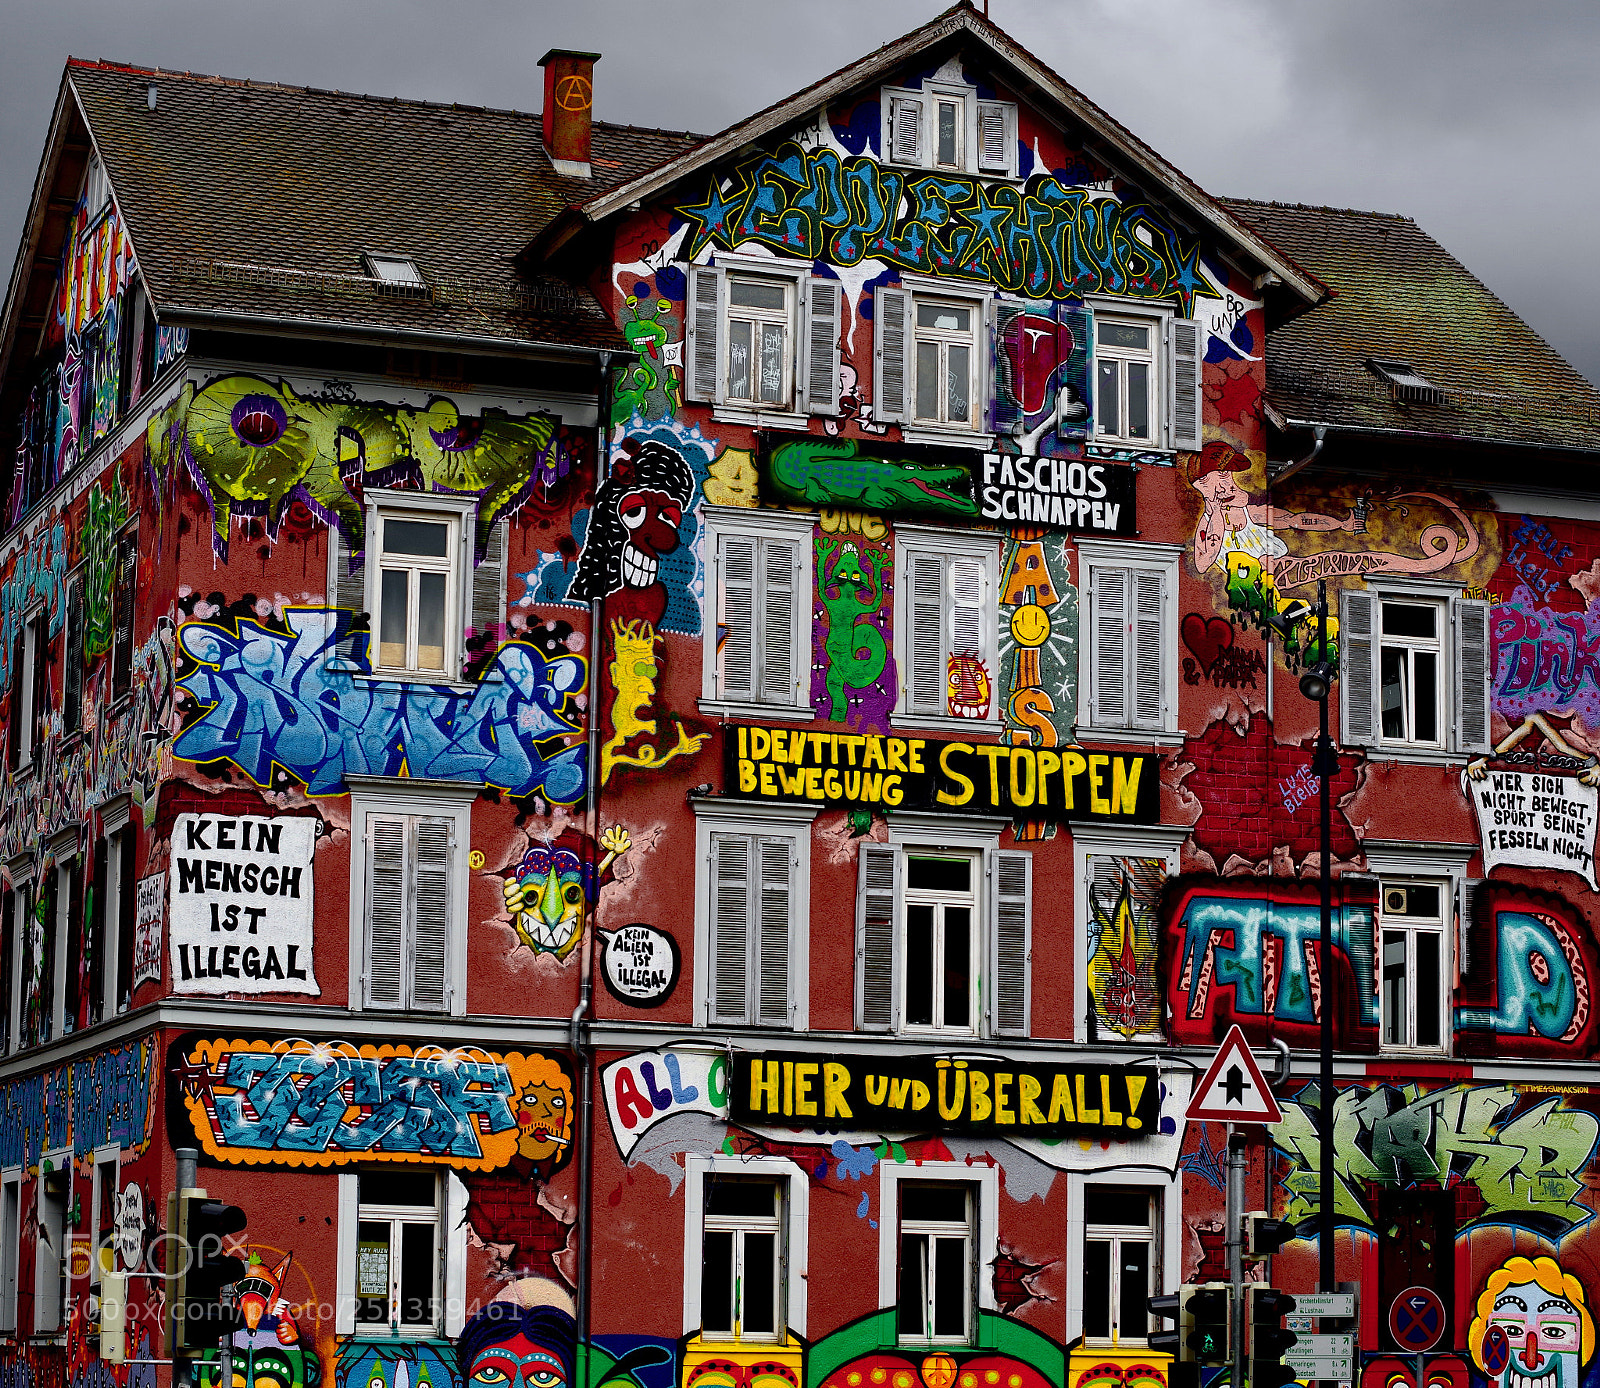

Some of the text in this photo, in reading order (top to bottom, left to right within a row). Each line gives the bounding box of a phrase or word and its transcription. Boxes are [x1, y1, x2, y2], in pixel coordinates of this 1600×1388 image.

[983, 454, 1107, 498] FASCHOS
[982, 487, 1120, 531] SCHNAPPEN
[1512, 515, 1574, 567] ZELLE
[1218, 645, 1267, 673] MAMA
[738, 727, 925, 773] IDENTITÄRE
[739, 763, 903, 806] BEWEGUNG
[936, 743, 1144, 815] STOPPEN
[1492, 774, 1564, 795] WER SICH
[1481, 791, 1592, 825] NICHT BEWEGT,
[1494, 809, 1586, 840] SPÜRT SEINE
[186, 819, 283, 854] KEIN
[1488, 830, 1591, 870] FESSELN NICHT
[178, 859, 300, 898] MENSCH
[211, 903, 267, 934] IST
[625, 929, 650, 940] KEIN
[179, 943, 307, 980] ILLEGAL
[750, 1060, 854, 1118] HIER
[865, 1074, 931, 1111] UND
[936, 1060, 1148, 1129] ÜBERALL!
